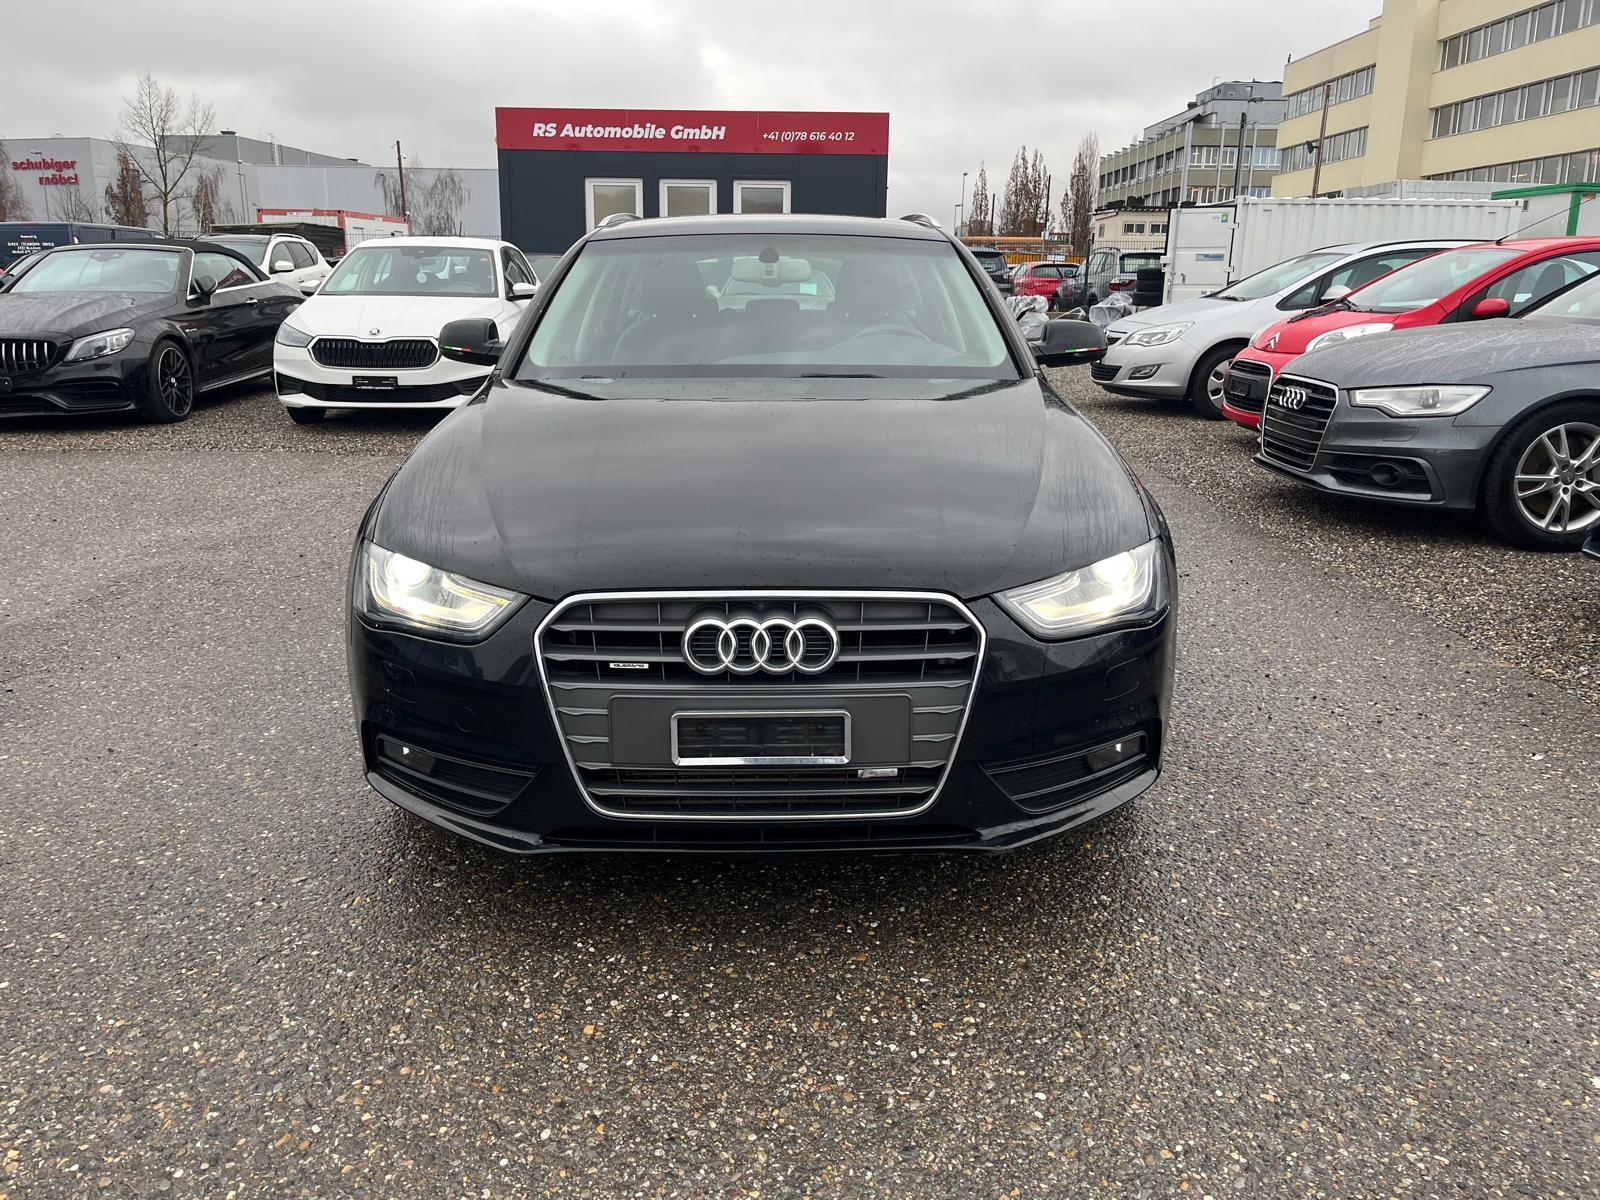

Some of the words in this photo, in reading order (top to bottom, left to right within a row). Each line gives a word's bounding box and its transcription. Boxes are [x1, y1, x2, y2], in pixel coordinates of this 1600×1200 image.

[533, 123, 557, 137] RS
[560, 123, 666, 139] Automobile
[670, 125, 726, 140] GmbH
[762, 131, 779, 141] +41
[781, 131, 807, 142] (0)78
[809, 131, 826, 141] 616
[828, 131, 842, 141] 40
[845, 131, 855, 141] 12
[12, 158, 77, 173] schubiger
[39, 173, 79, 185] möbel
